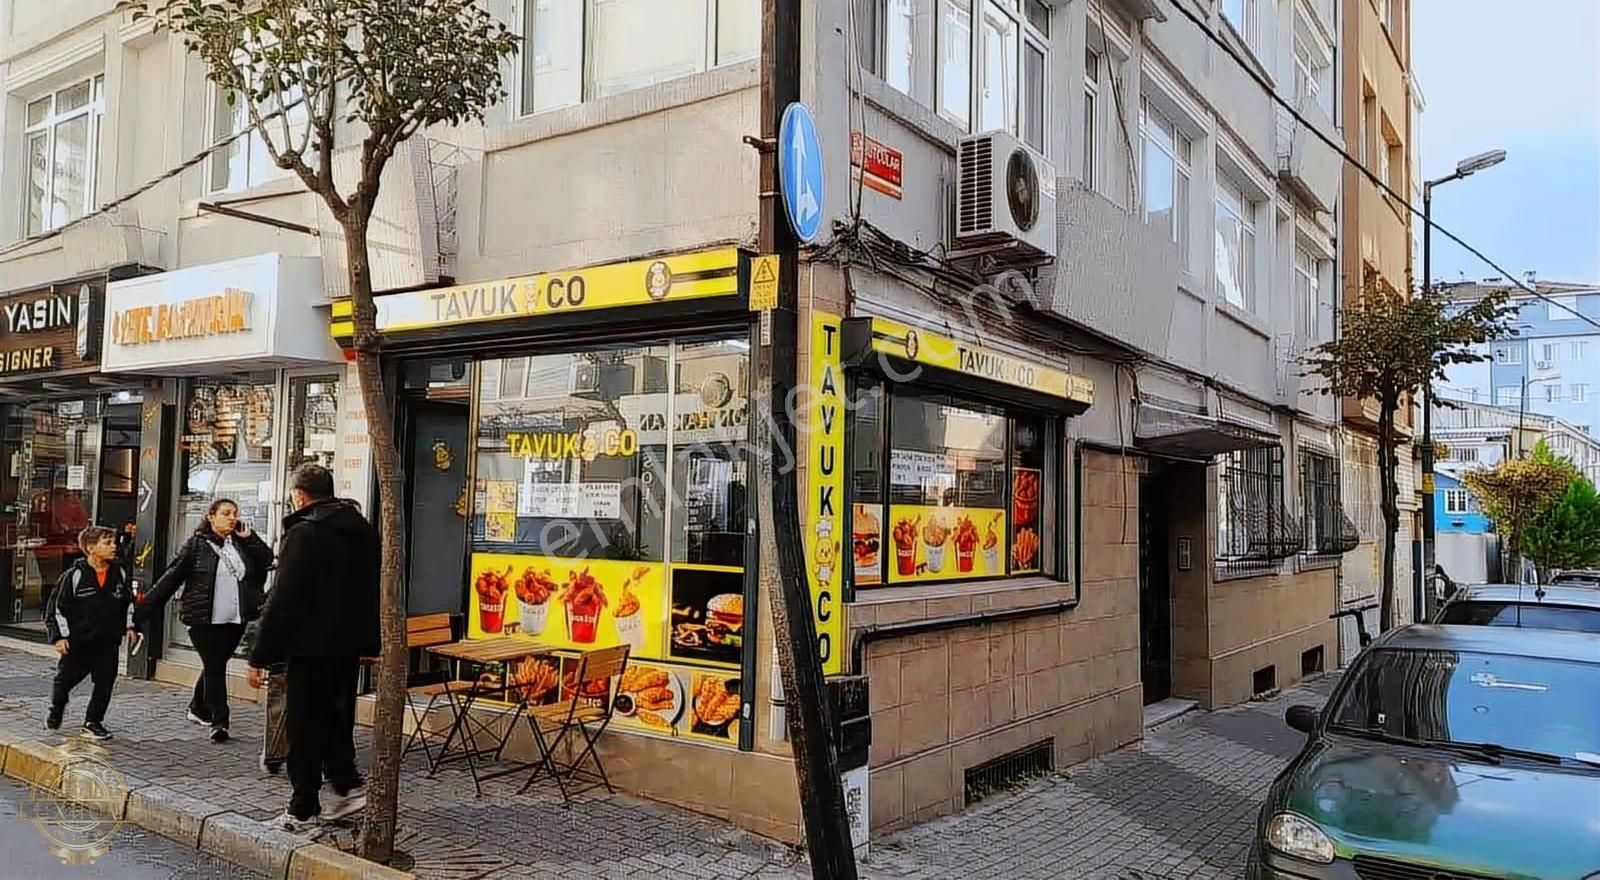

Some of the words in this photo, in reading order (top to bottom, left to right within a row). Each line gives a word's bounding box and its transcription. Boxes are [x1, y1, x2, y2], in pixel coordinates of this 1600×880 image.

[431, 284, 517, 321] TAVUK
[547, 275, 586, 309] CO
[958, 347, 1004, 379] TAVUK
[820, 325, 837, 517] TAVUK
[506, 432, 579, 459] TAVUK
[605, 429, 638, 457] CO
